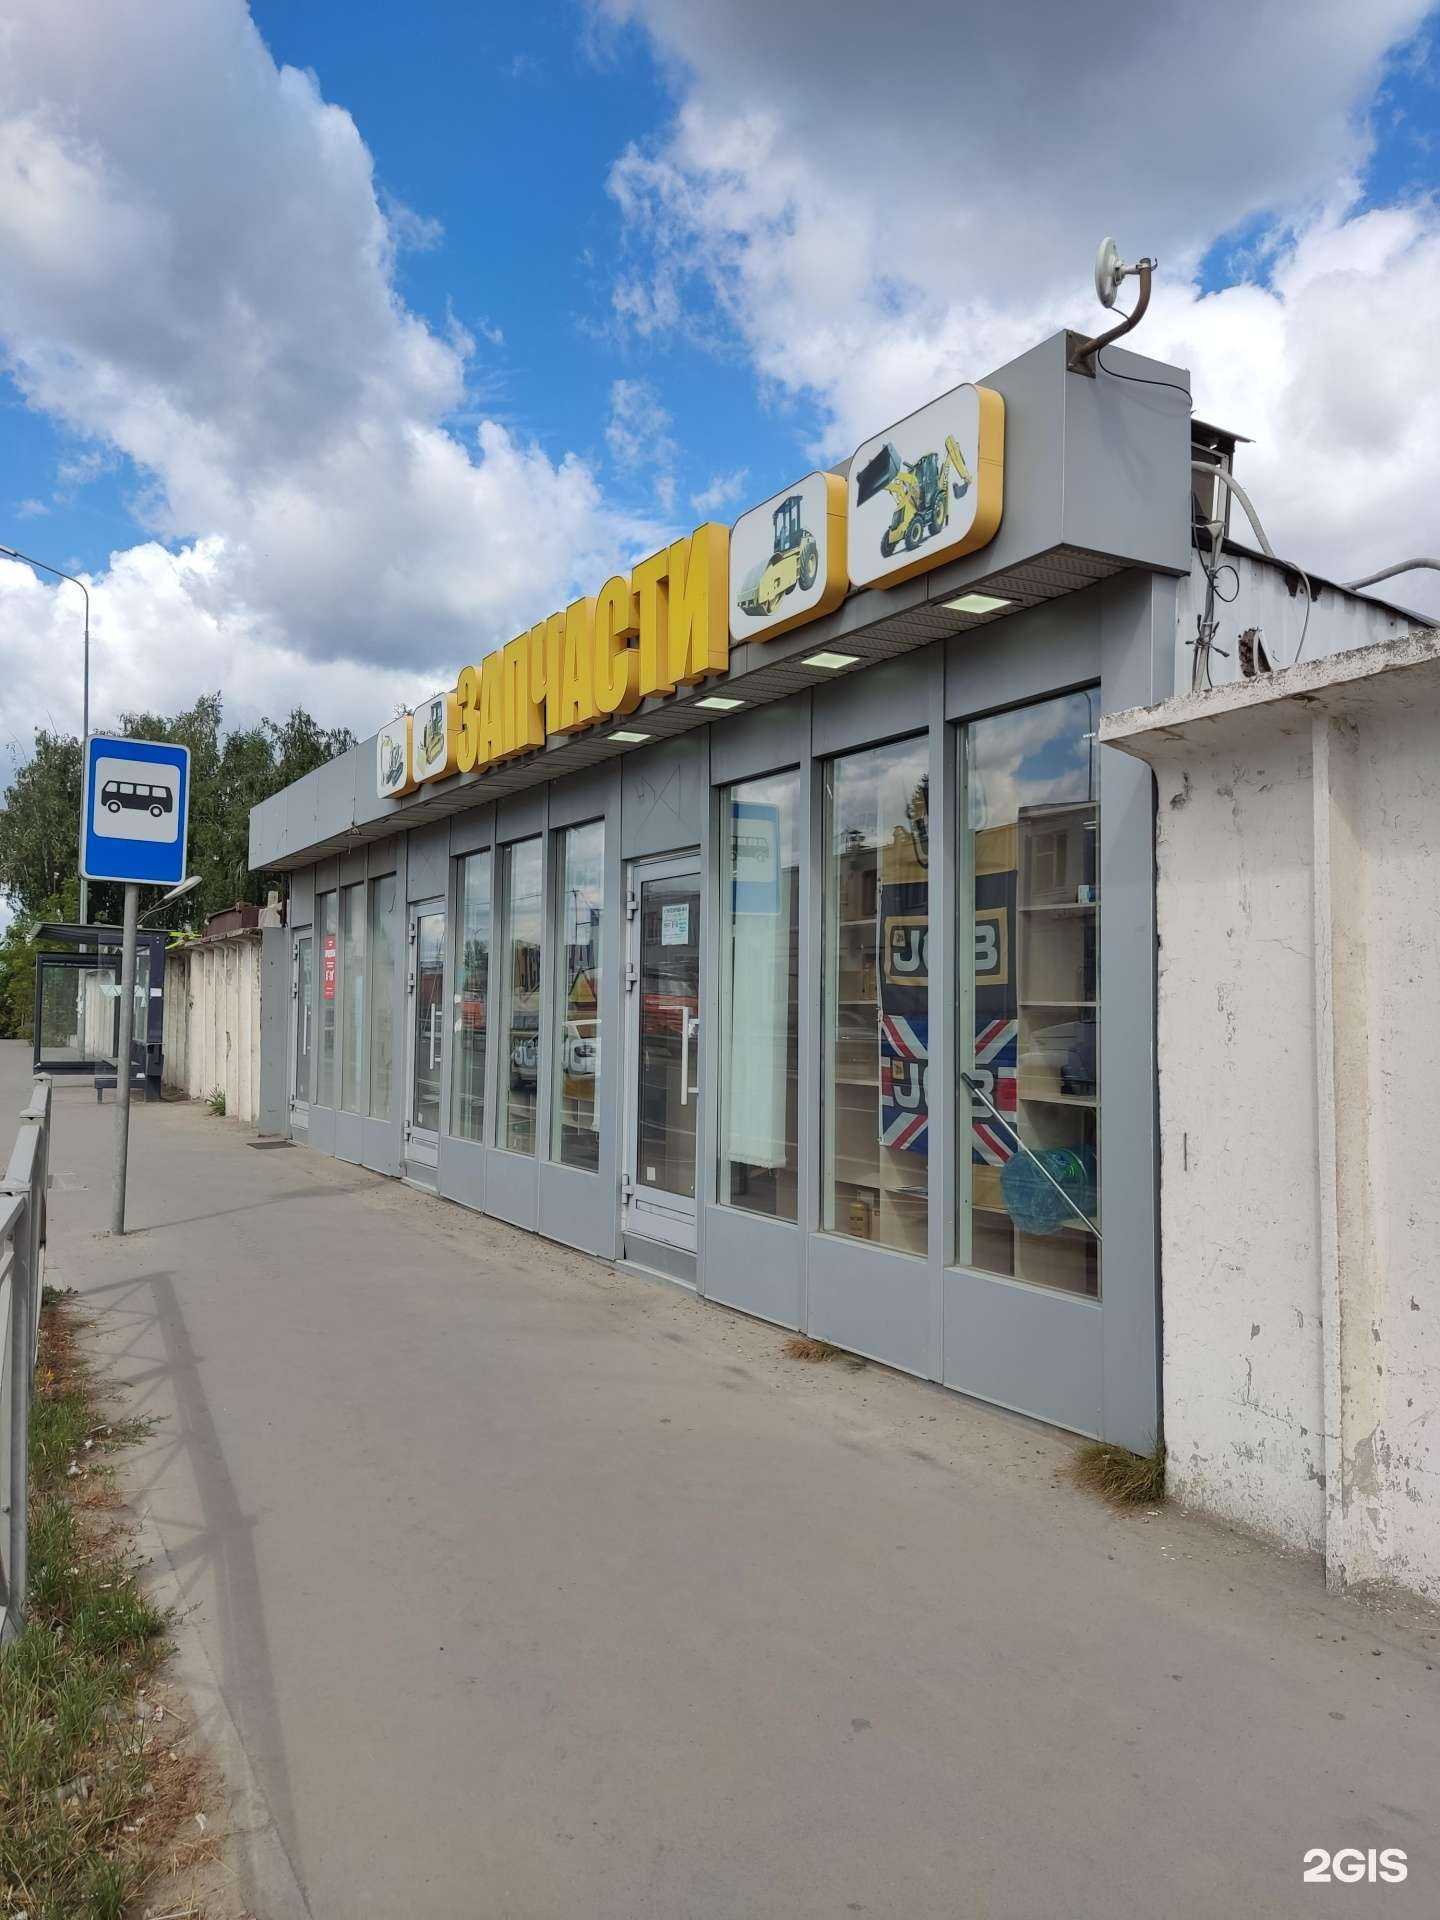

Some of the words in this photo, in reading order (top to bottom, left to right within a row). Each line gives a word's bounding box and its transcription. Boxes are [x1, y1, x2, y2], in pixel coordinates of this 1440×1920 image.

[456, 522, 729, 773] ЗАПЧАСТИ
[893, 925, 998, 971] JB
[893, 1062, 994, 1118] JB
